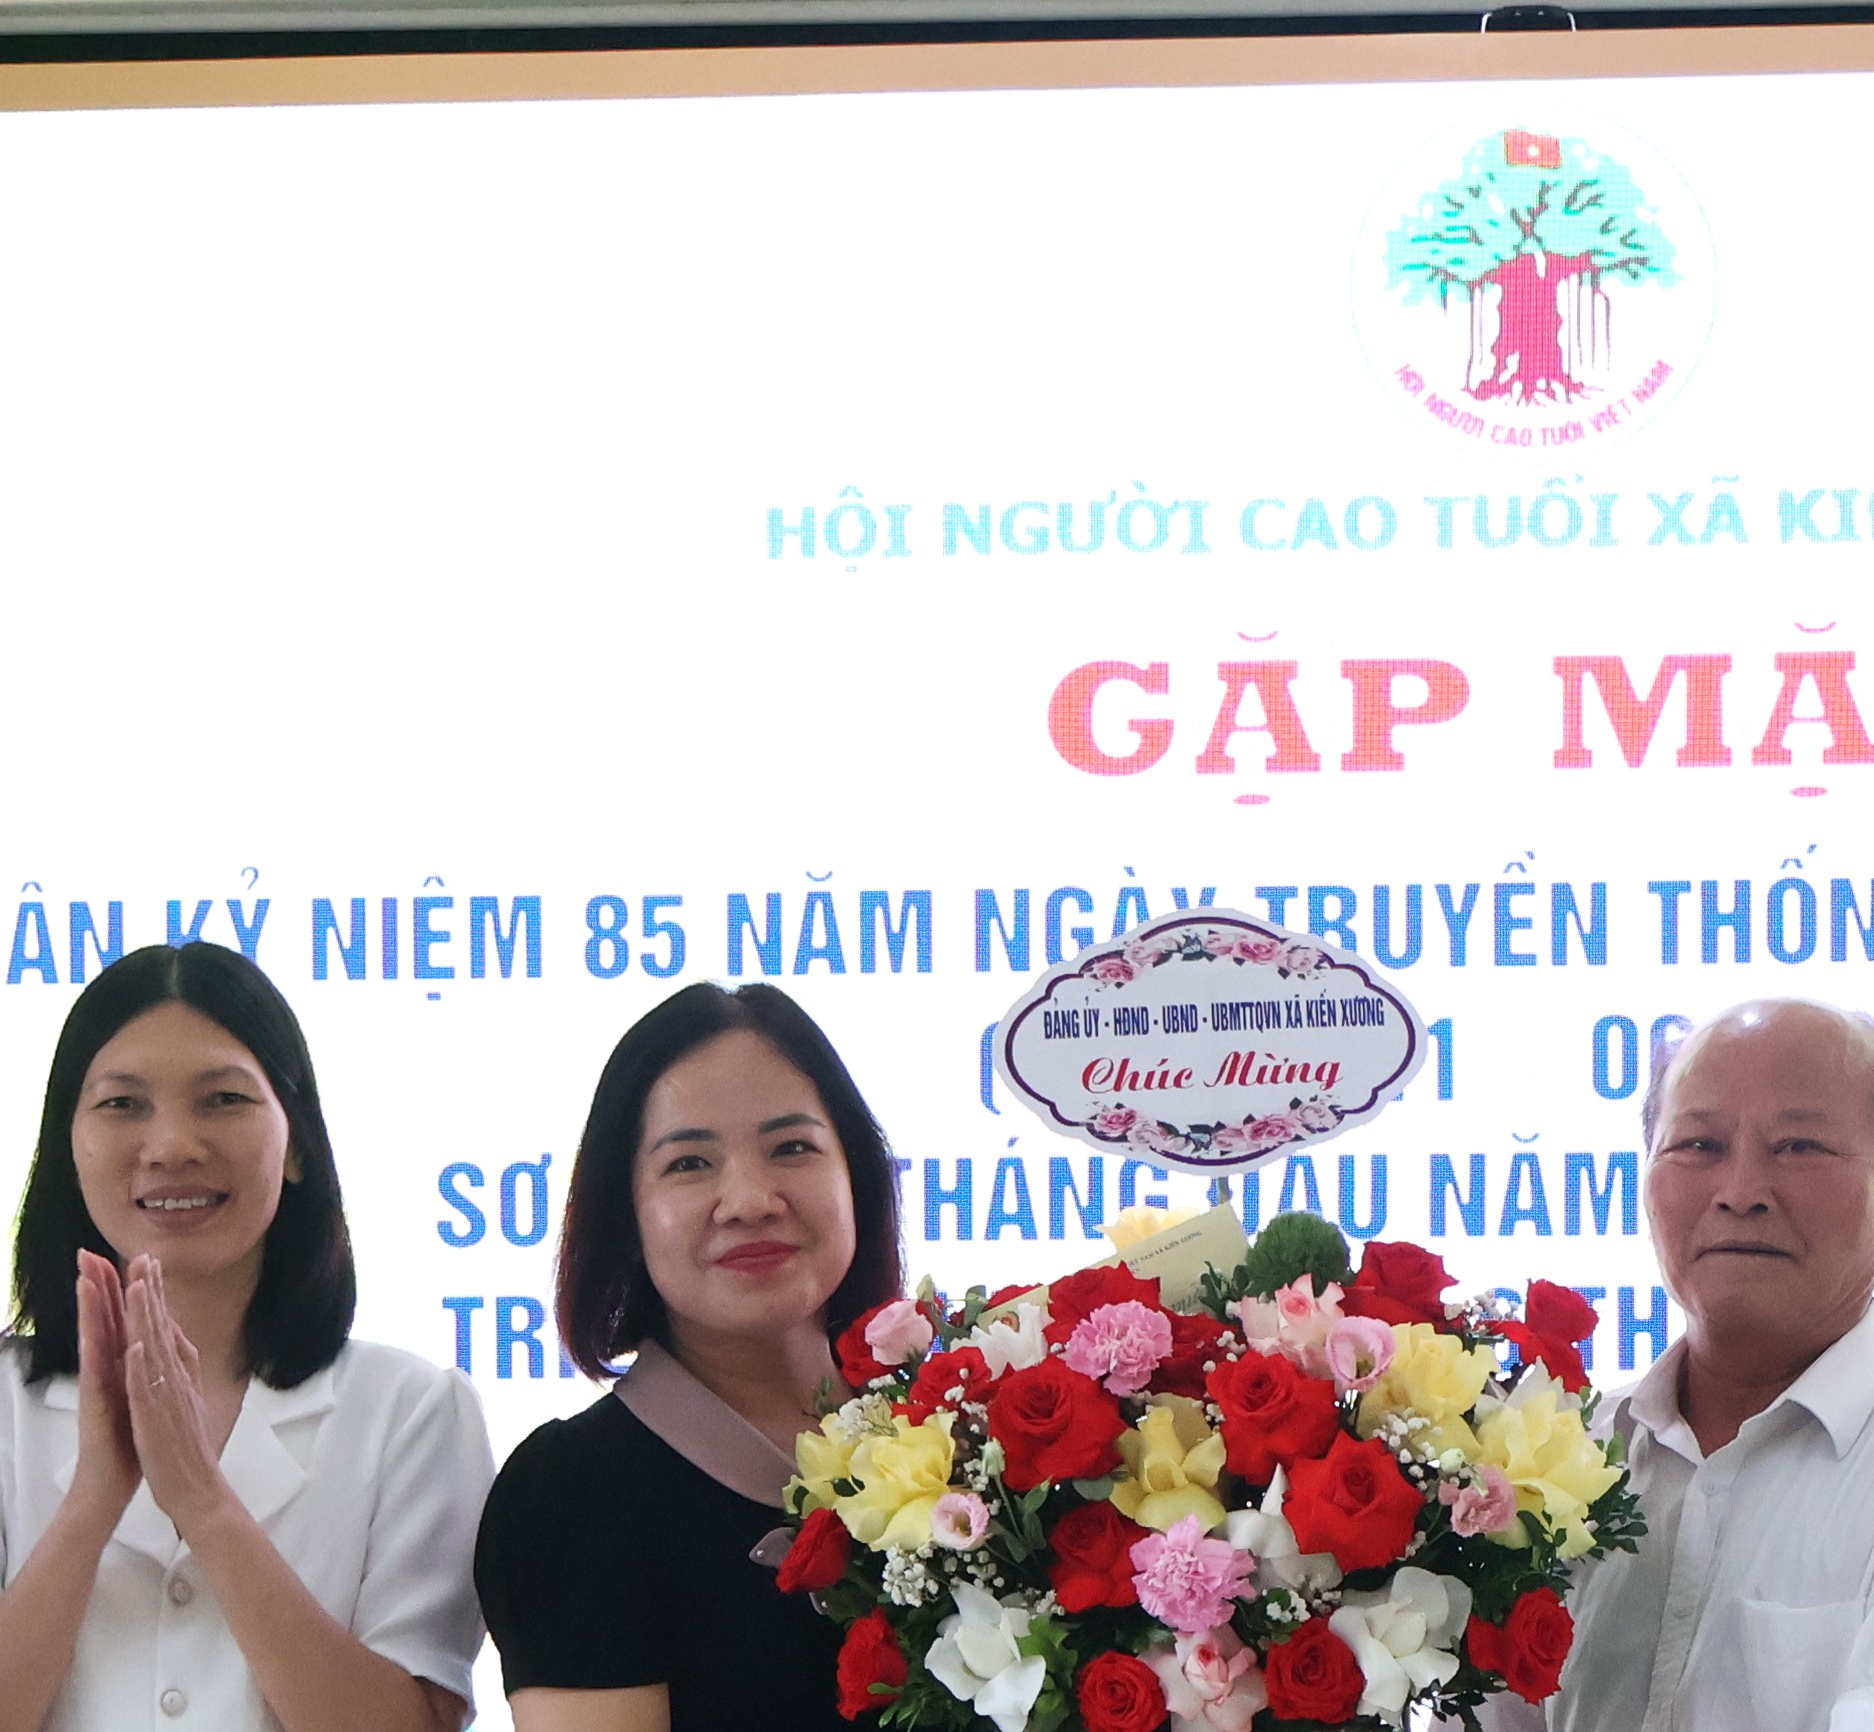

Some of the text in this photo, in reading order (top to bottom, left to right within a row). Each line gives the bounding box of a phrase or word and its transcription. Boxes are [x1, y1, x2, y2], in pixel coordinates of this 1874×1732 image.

[1491, 424, 1533, 447] CAO
[767, 485, 913, 573] HỘI
[942, 480, 1211, 556] NGƯỜI
[1240, 495, 1398, 551] CAO
[1424, 474, 1620, 548] TUỔI
[1647, 475, 1749, 545] XÃ
[1047, 631, 1471, 806] GẶP
[312, 876, 543, 1002] NIỆM
[584, 895, 687, 979] 85
[727, 872, 933, 977] NĂM
[1044, 997, 1080, 1039] ĐẢNG
[1113, 1006, 1149, 1036] HĐND
[1162, 1004, 1199, 1034] UBND
[1211, 1000, 1282, 1033] UBMTTQVN
[1285, 994, 1304, 1029] XÃ
[1306, 988, 1337, 1028] KIẾN
[1340, 995, 1386, 1027] XƯƠNG
[1081, 1056, 1194, 1094] Chúc
[1203, 1050, 1344, 1090] Mừng
[437, 1152, 553, 1248] SƠ
[895, 1136, 1169, 1241] HÁNG
[1430, 1133, 1639, 1237] NĂM
